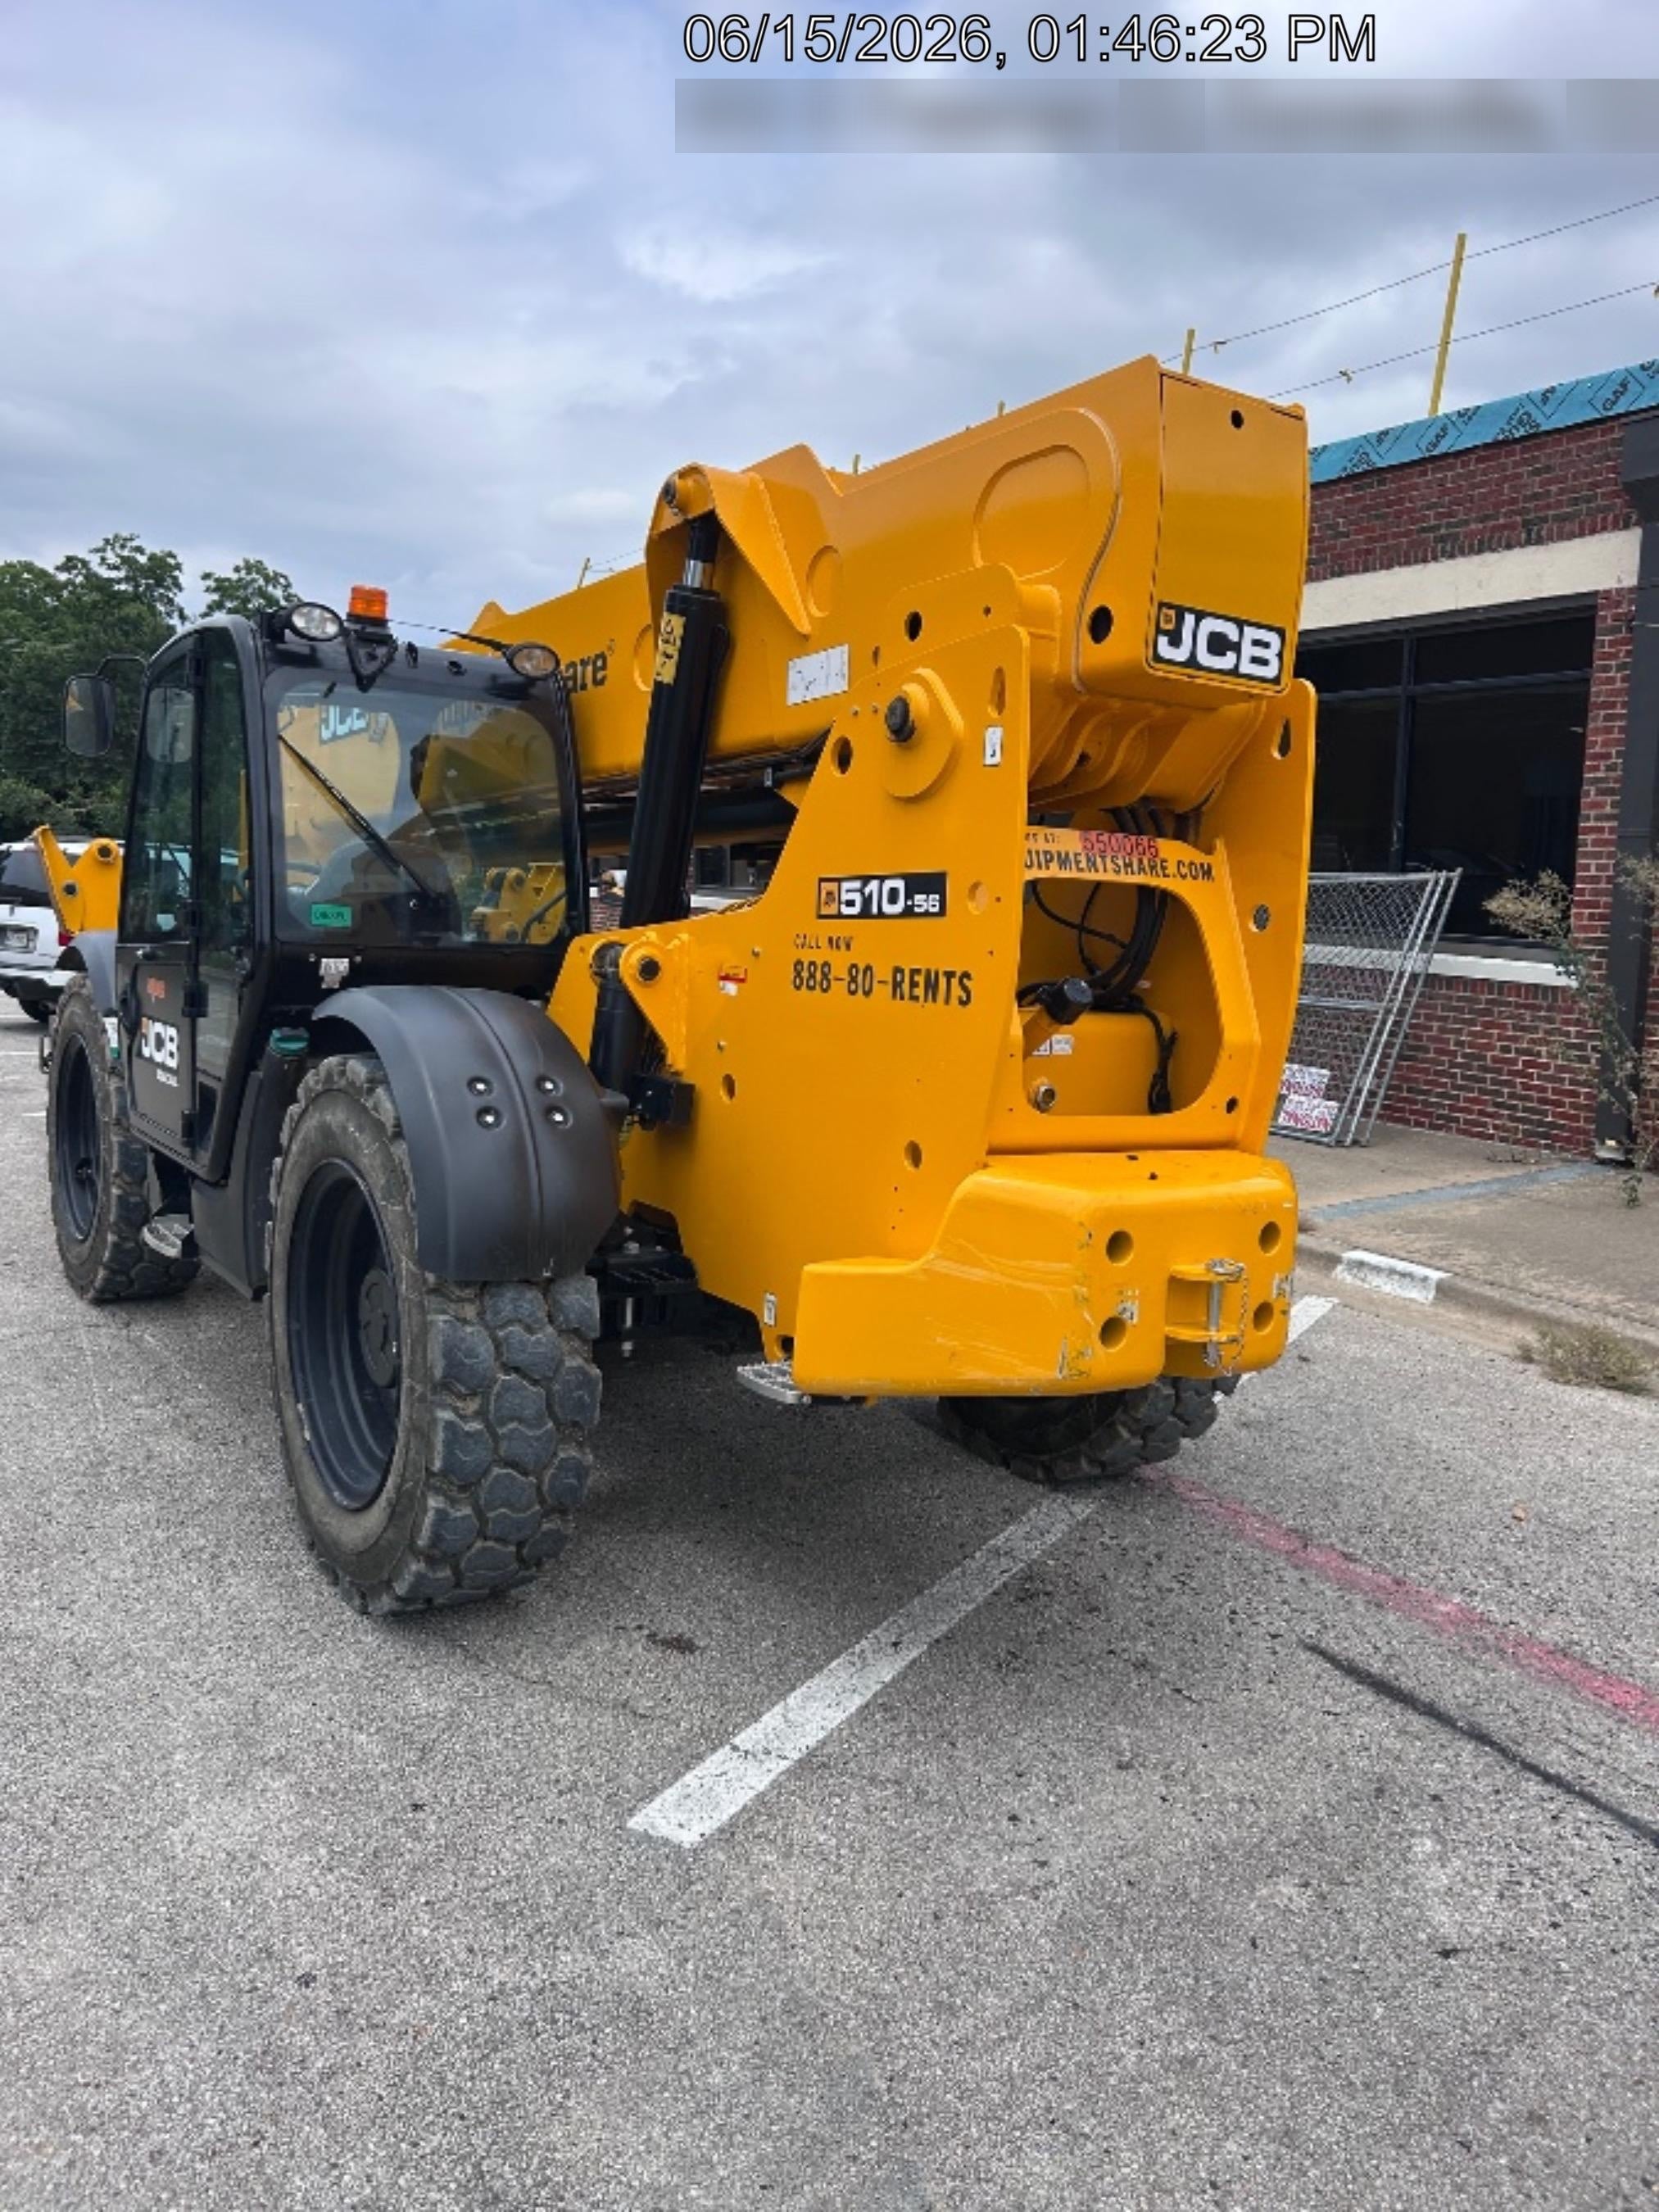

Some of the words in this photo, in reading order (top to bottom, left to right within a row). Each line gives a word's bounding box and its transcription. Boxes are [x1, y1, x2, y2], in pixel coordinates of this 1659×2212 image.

[1158, 611, 1281, 679] JCB
[562, 650, 607, 693] are
[1024, 850, 1215, 882] UIPMENTSHARE.COM
[794, 934, 821, 950] CALL
[828, 936, 853, 951] NOW
[792, 959, 972, 1008] 888-80-RENTS
[142, 1019, 178, 1069] JCB
